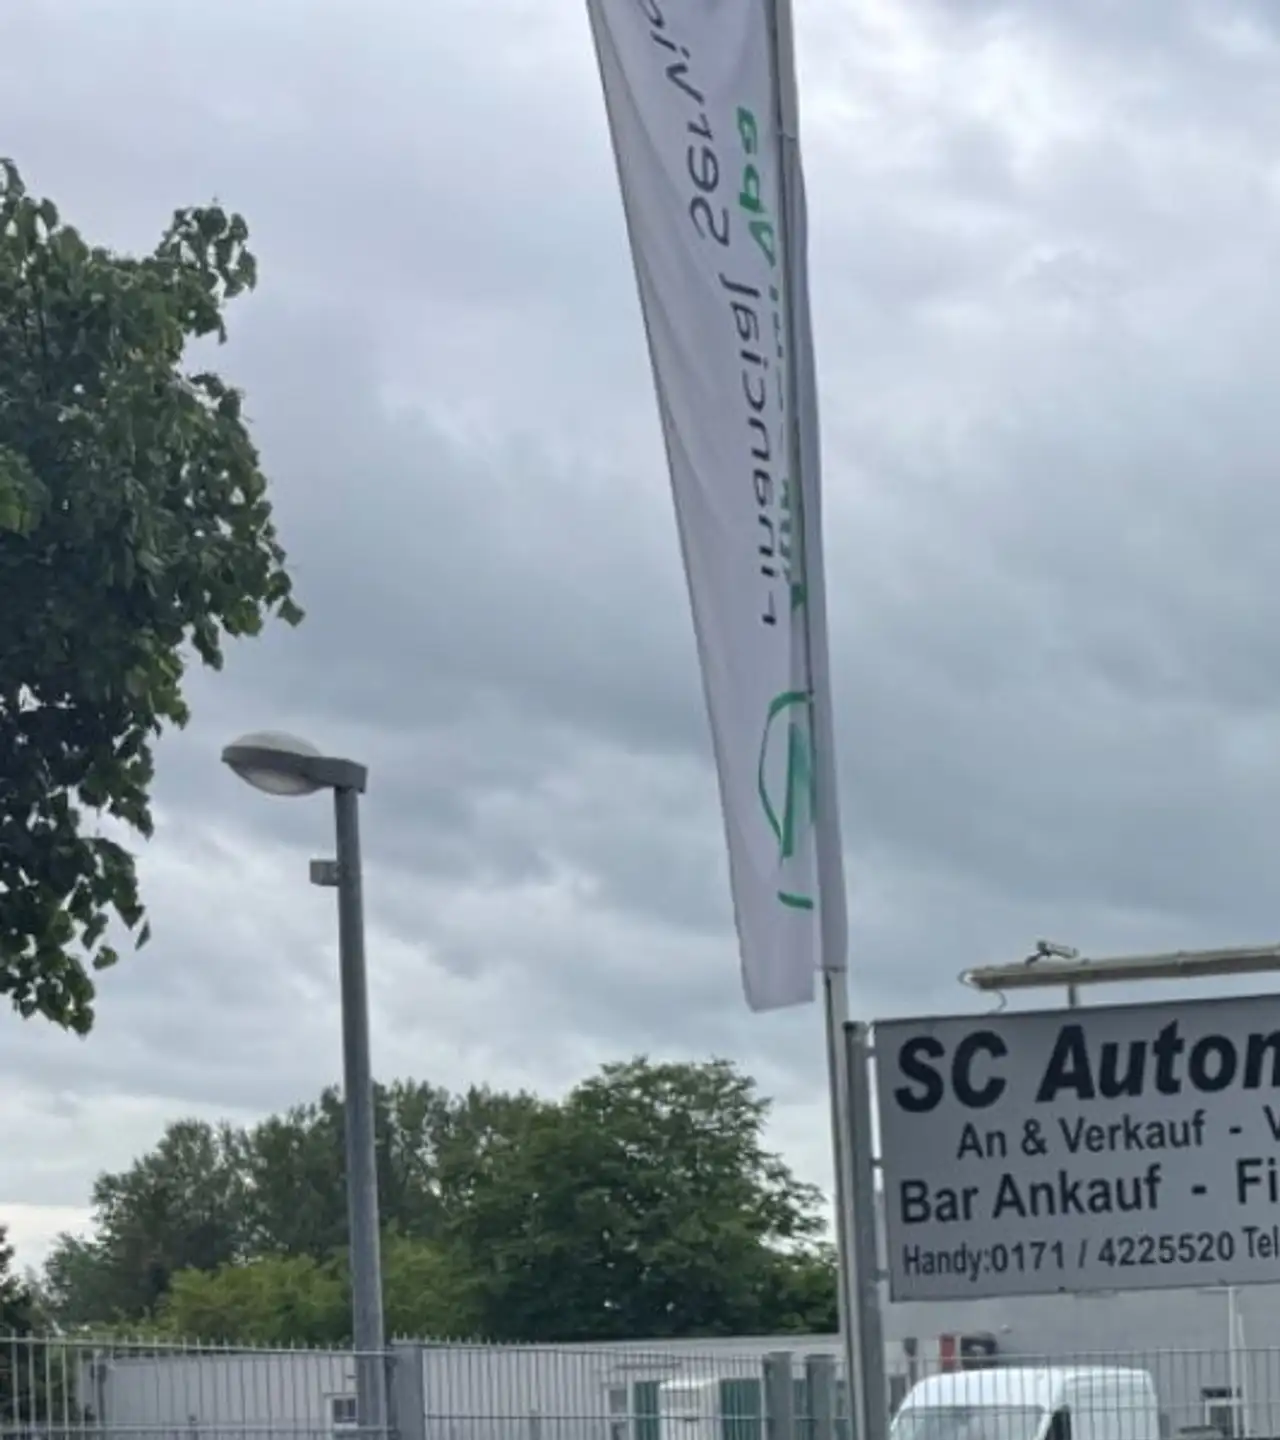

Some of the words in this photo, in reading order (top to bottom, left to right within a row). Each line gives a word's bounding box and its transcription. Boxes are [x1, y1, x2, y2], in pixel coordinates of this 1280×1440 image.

[894, 1030, 1008, 1113] SC
[957, 1122, 1007, 1159] An
[1021, 1118, 1047, 1156] &
[1058, 1109, 1206, 1152] Verkauf
[900, 1179, 979, 1224] Bar
[992, 1163, 1161, 1219] Ankauf
[1098, 1231, 1235, 1266] 4225520
[1242, 1225, 1280, 1260] Tel
